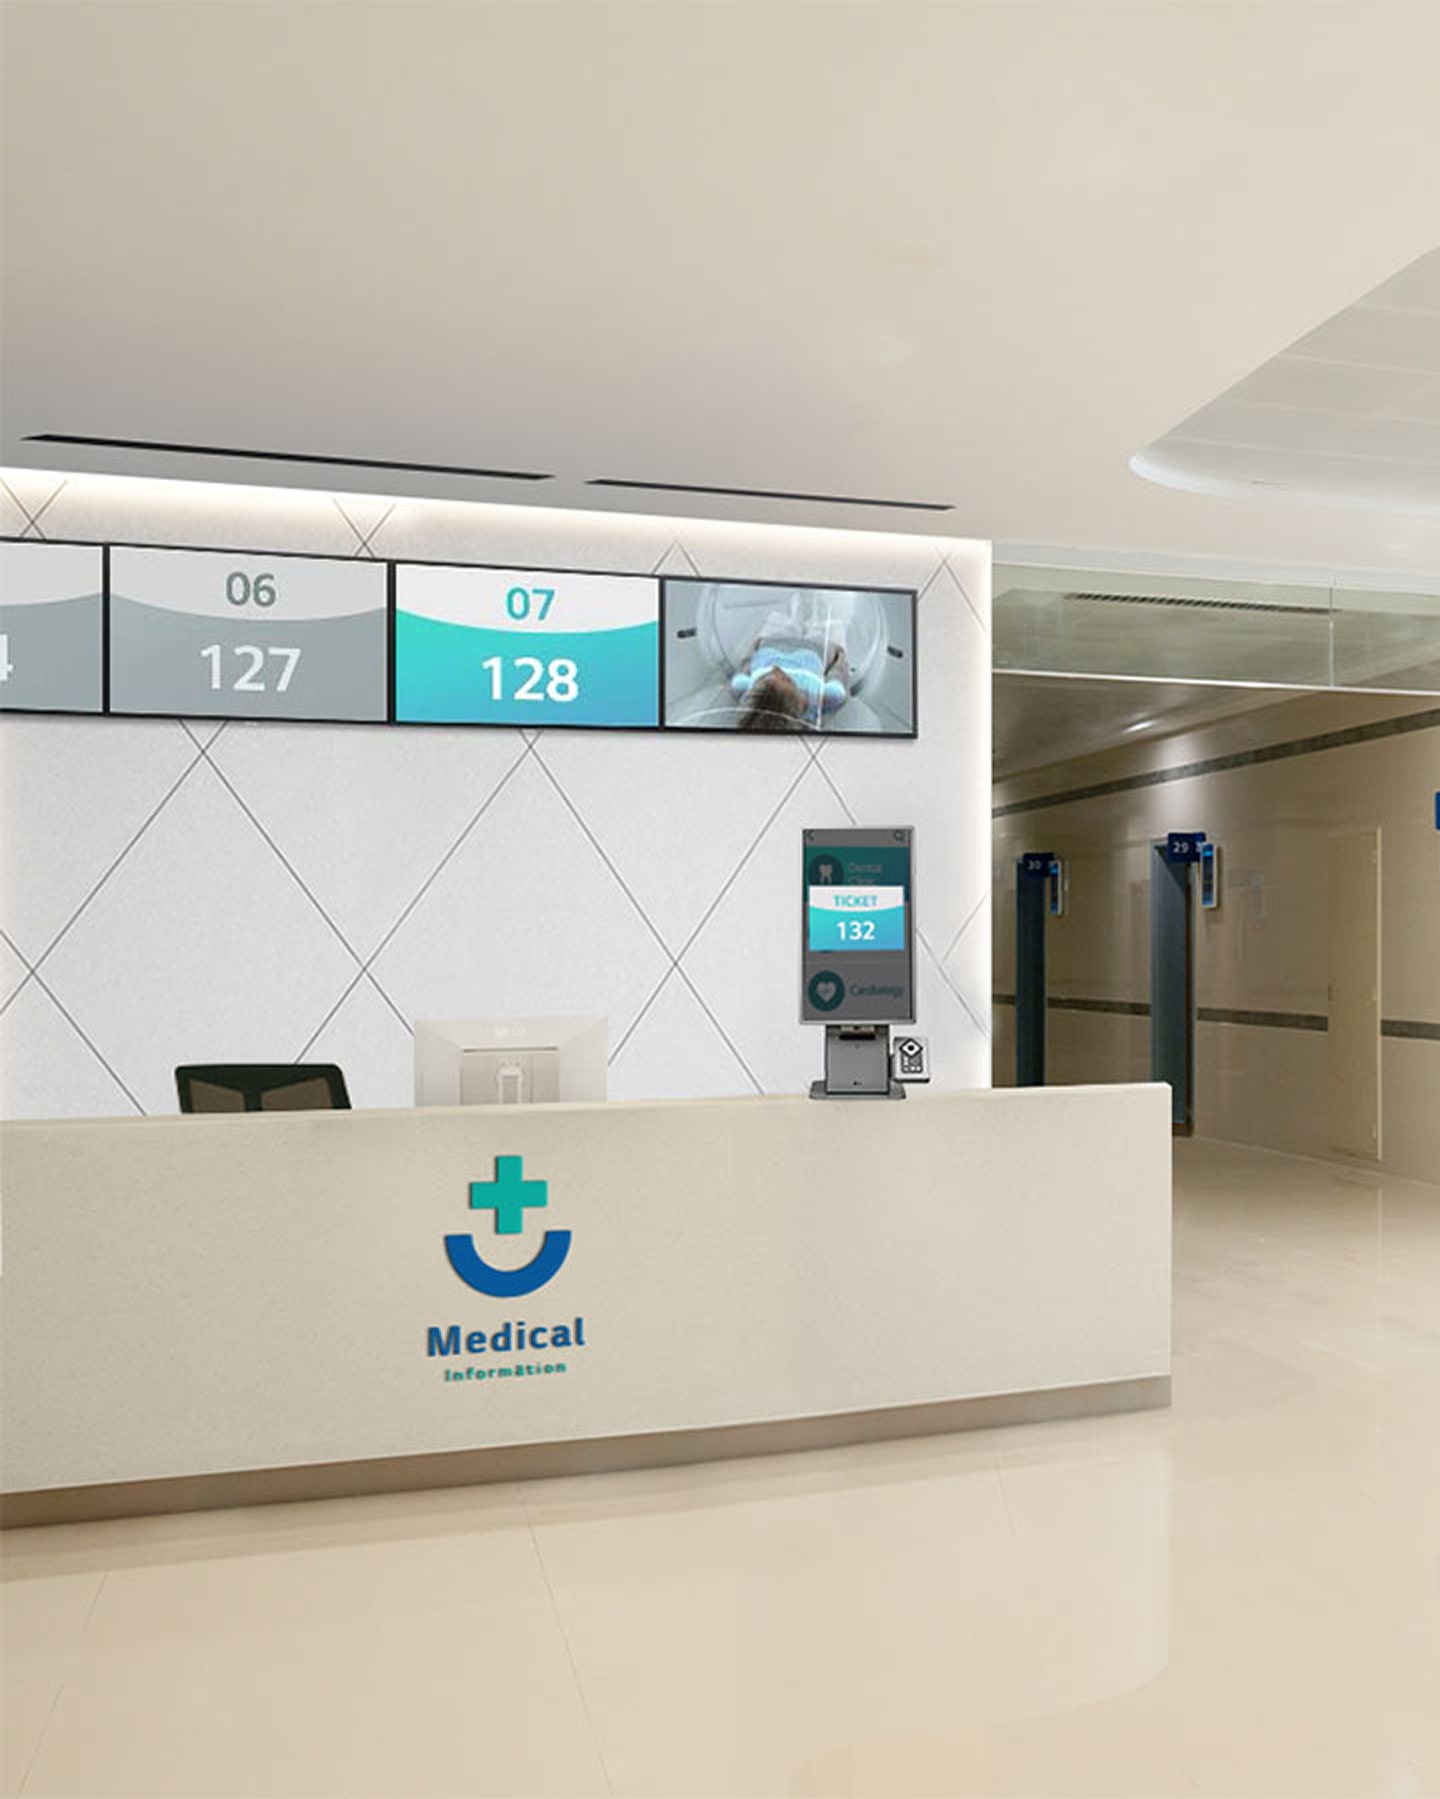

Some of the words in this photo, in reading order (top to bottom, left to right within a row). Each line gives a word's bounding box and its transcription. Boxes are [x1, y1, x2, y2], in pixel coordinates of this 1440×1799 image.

[226, 571, 277, 606] 06
[506, 587, 556, 621] 07
[200, 643, 301, 692] 127
[481, 656, 578, 701] 128
[1173, 841, 1189, 854] 29
[833, 895, 878, 907] TICKET
[837, 921, 875, 940] 132
[427, 1317, 586, 1357] Medical
[444, 1362, 567, 1382] Information
